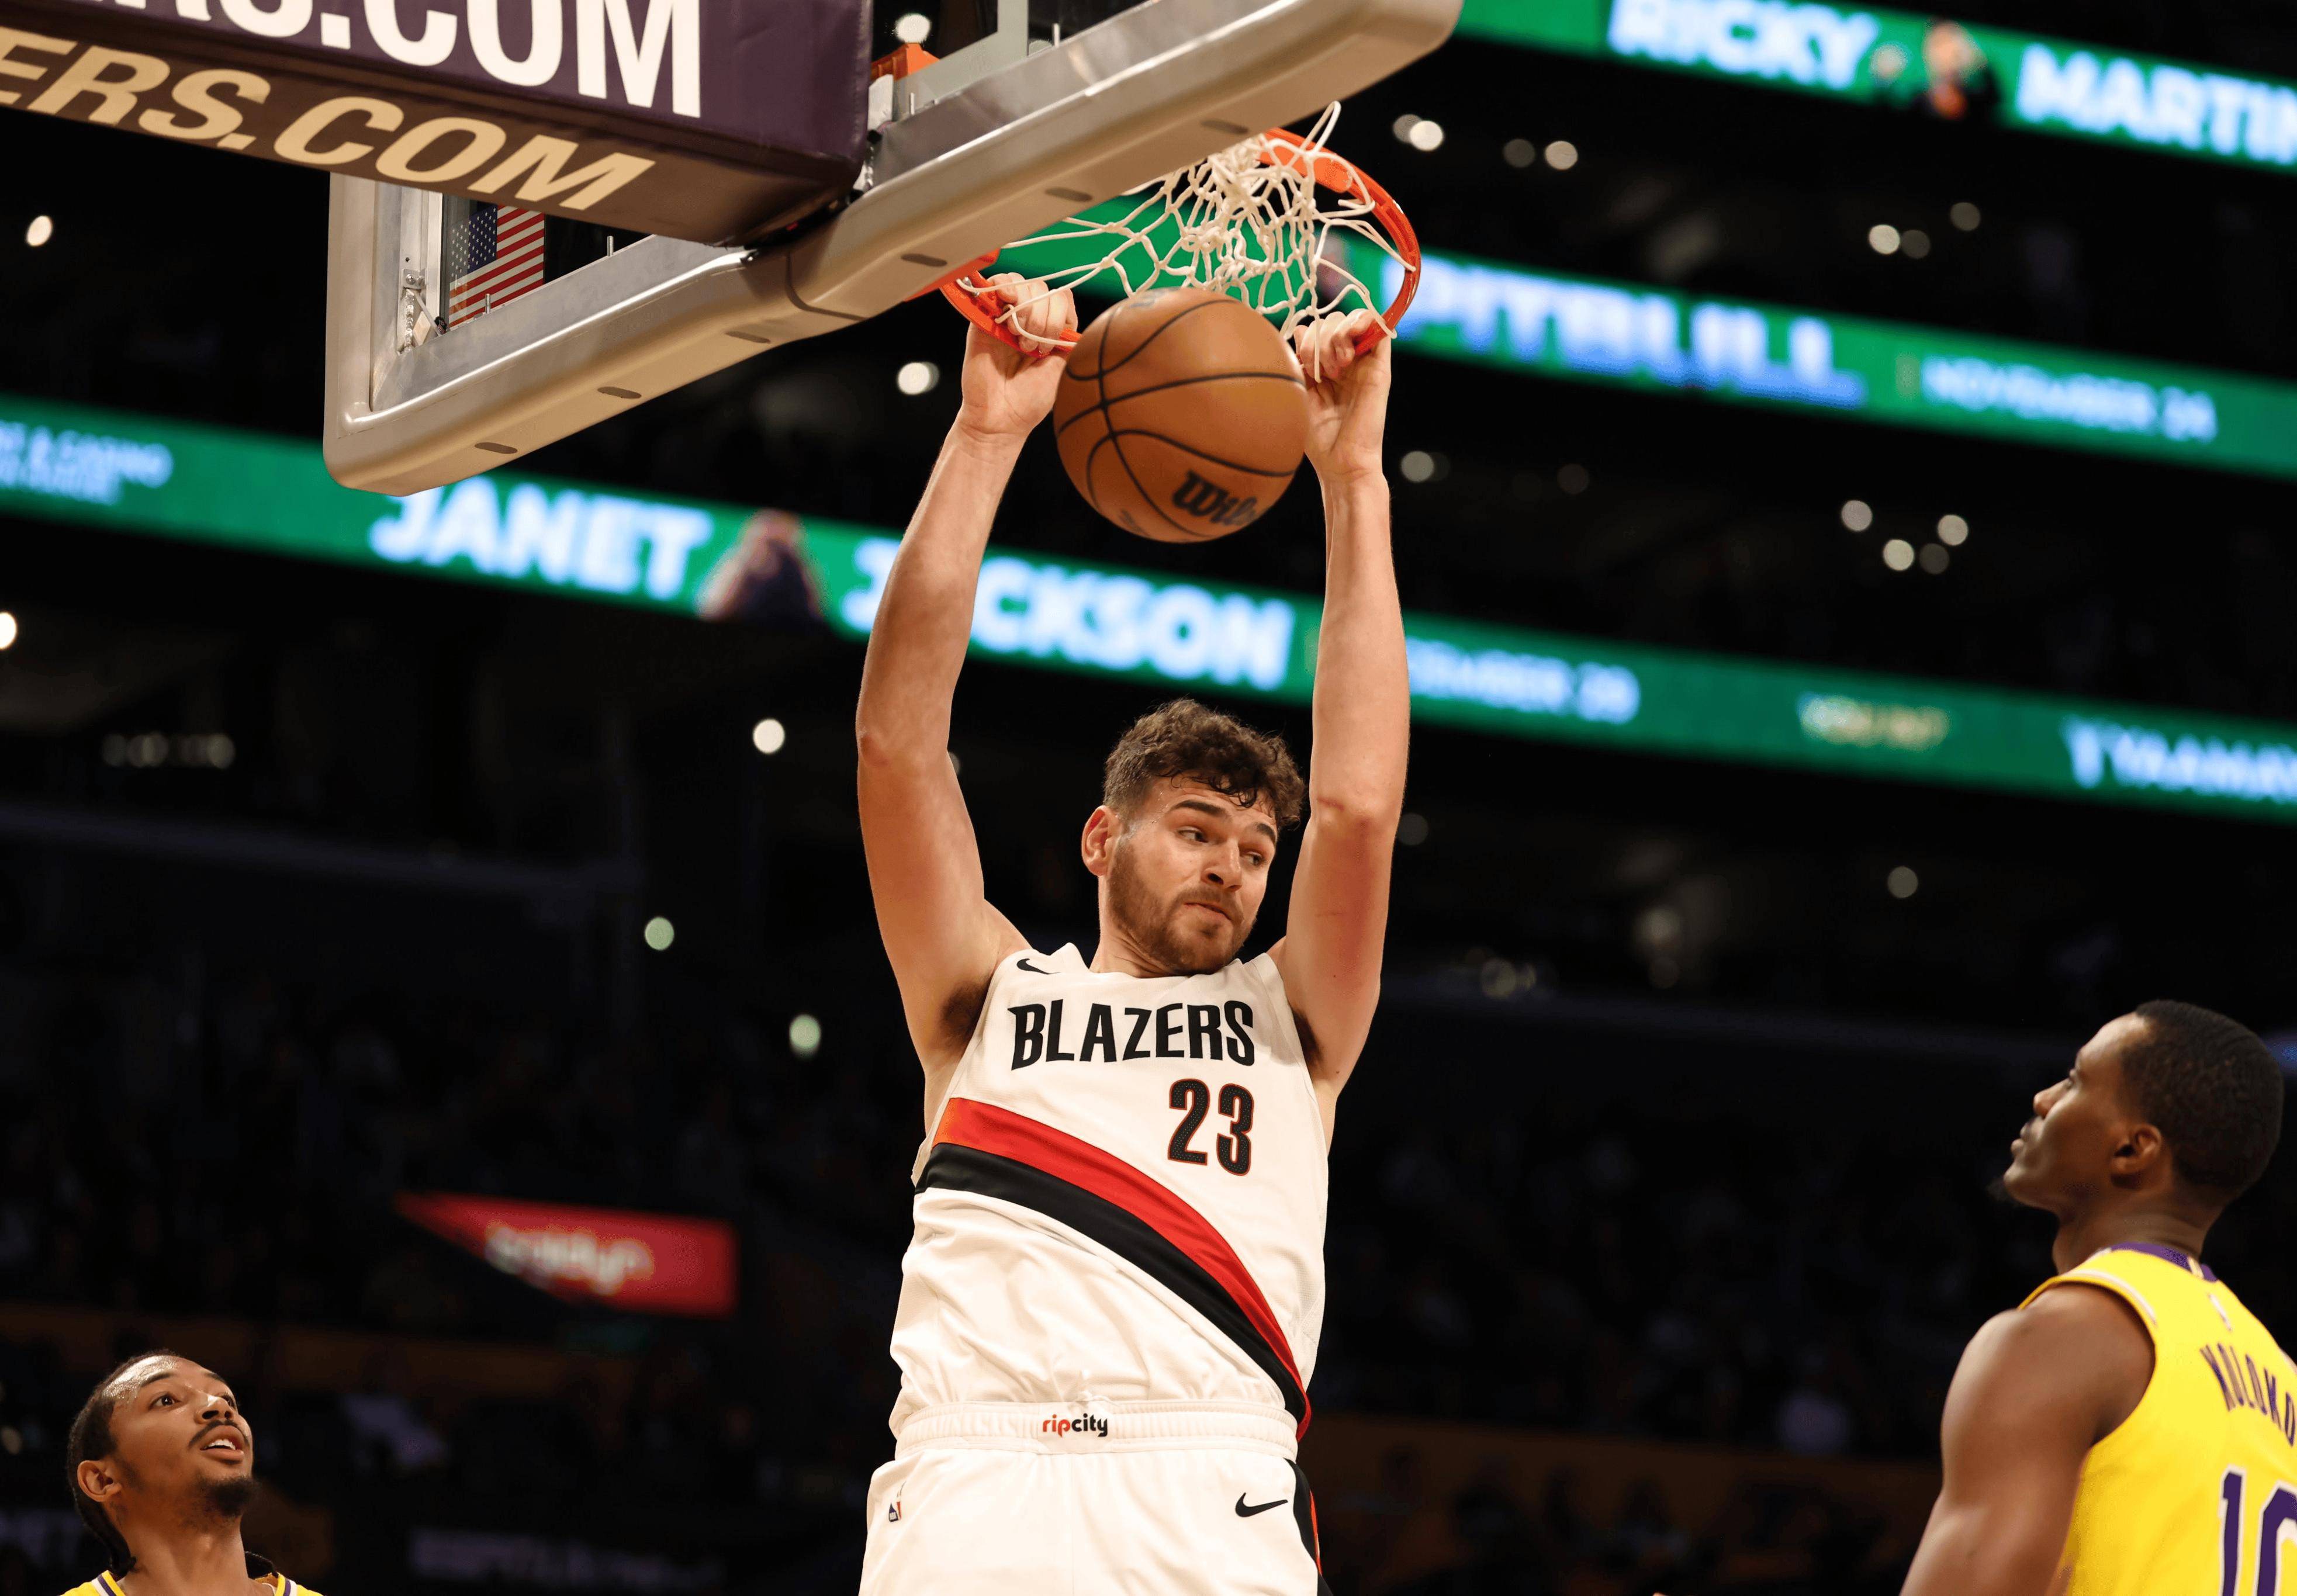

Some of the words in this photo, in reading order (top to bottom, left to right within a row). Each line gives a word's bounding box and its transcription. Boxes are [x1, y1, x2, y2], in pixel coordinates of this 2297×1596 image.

[371, 475, 713, 601] JANET
[840, 535, 1295, 692] JCKSON
[1007, 999, 1255, 1071] BLAZERS
[1167, 1078, 1254, 1176] 23
[1043, 1413, 1108, 1438] ripcity
